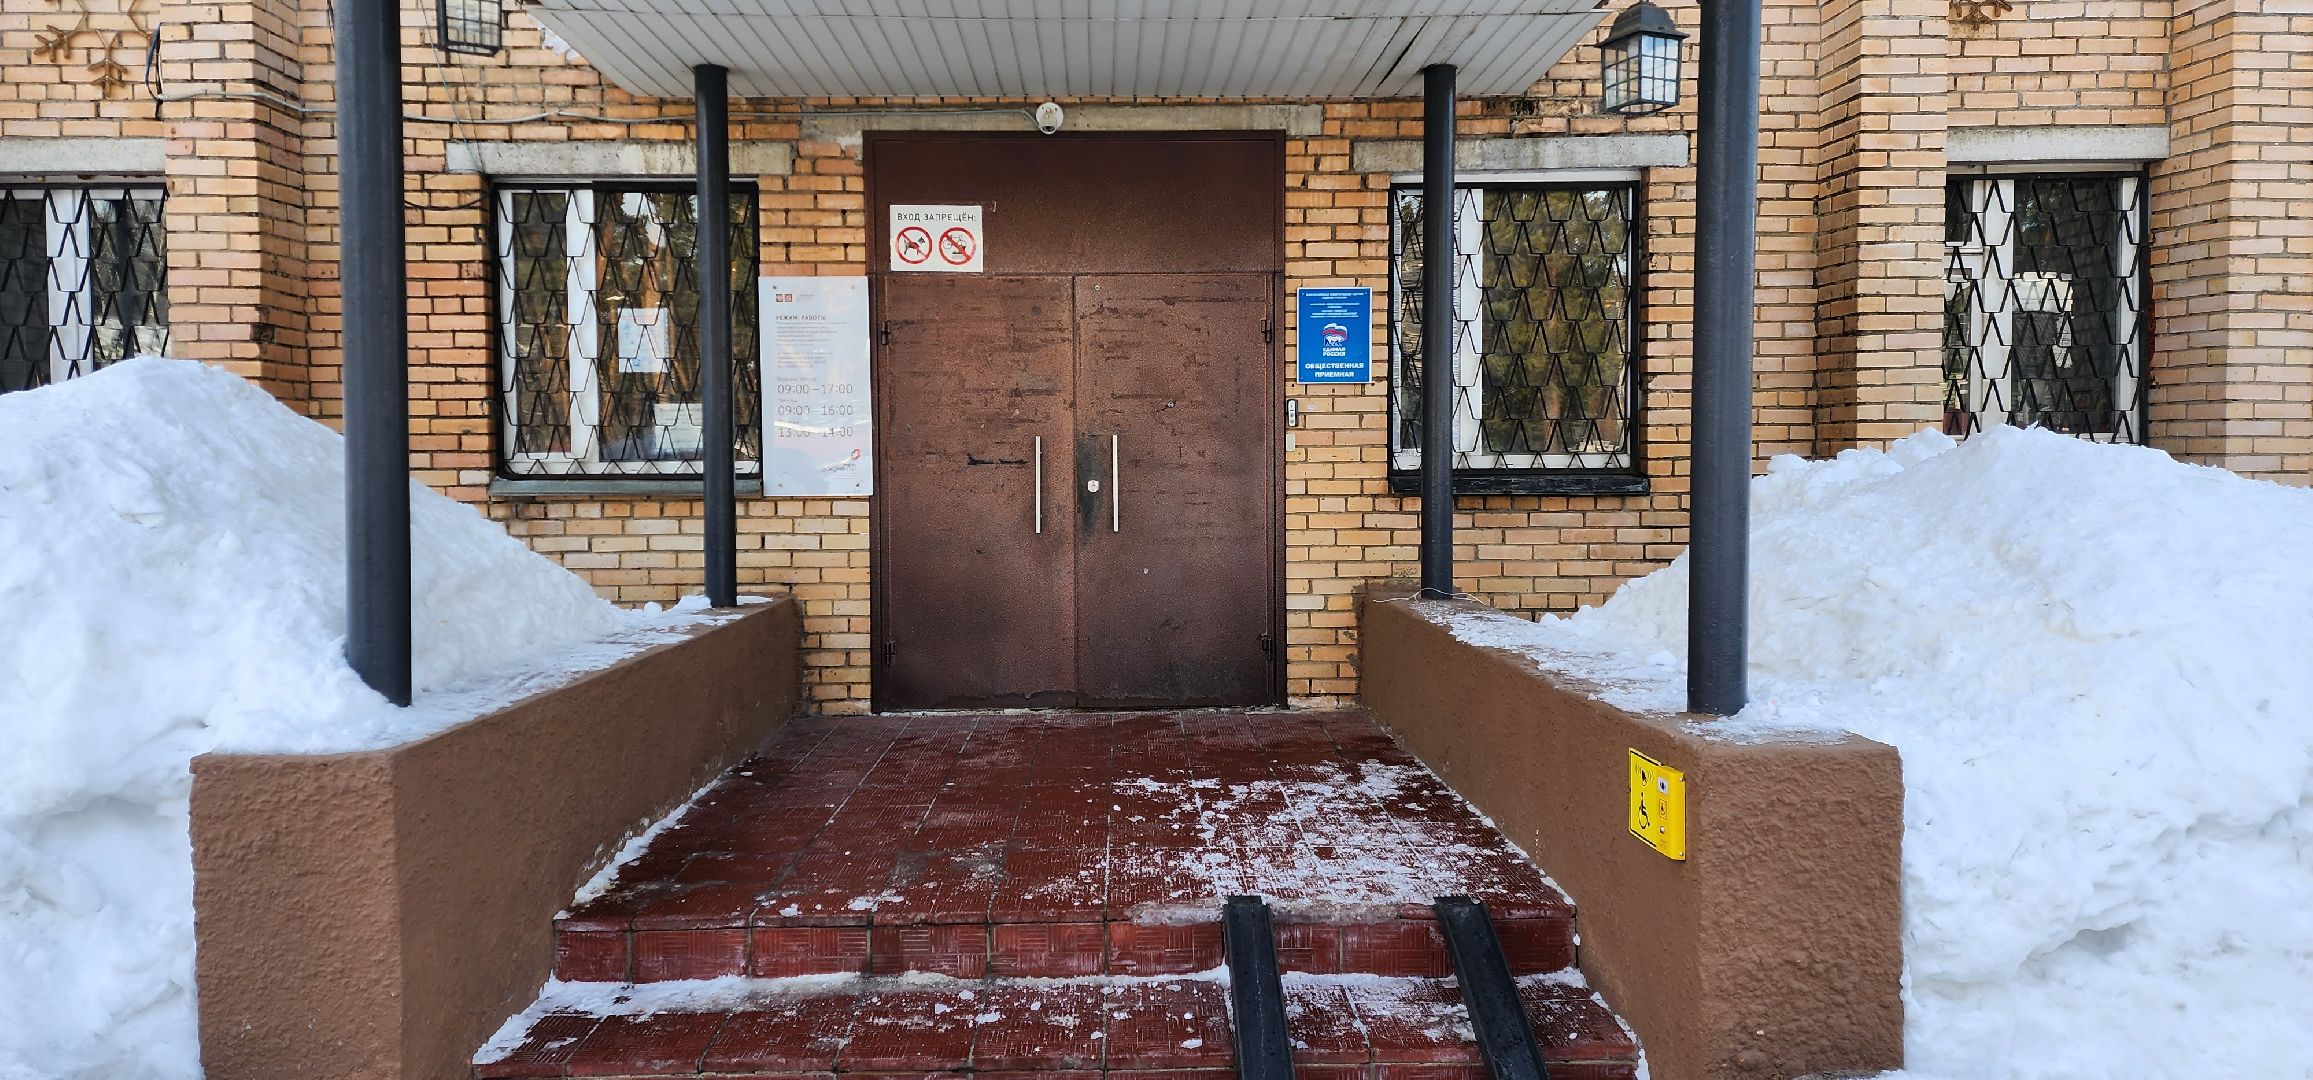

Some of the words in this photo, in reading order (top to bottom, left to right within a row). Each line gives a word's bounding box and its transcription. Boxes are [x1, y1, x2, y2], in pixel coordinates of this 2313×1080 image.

[897, 213, 920, 222] ВХОД
[924, 212, 976, 222] ЗАПРЕЩЁН:
[777, 384, 809, 395] 09:00
[822, 384, 853, 394] 17:00
[777, 405, 810, 416] 09:00
[821, 405, 853, 416] 16:00
